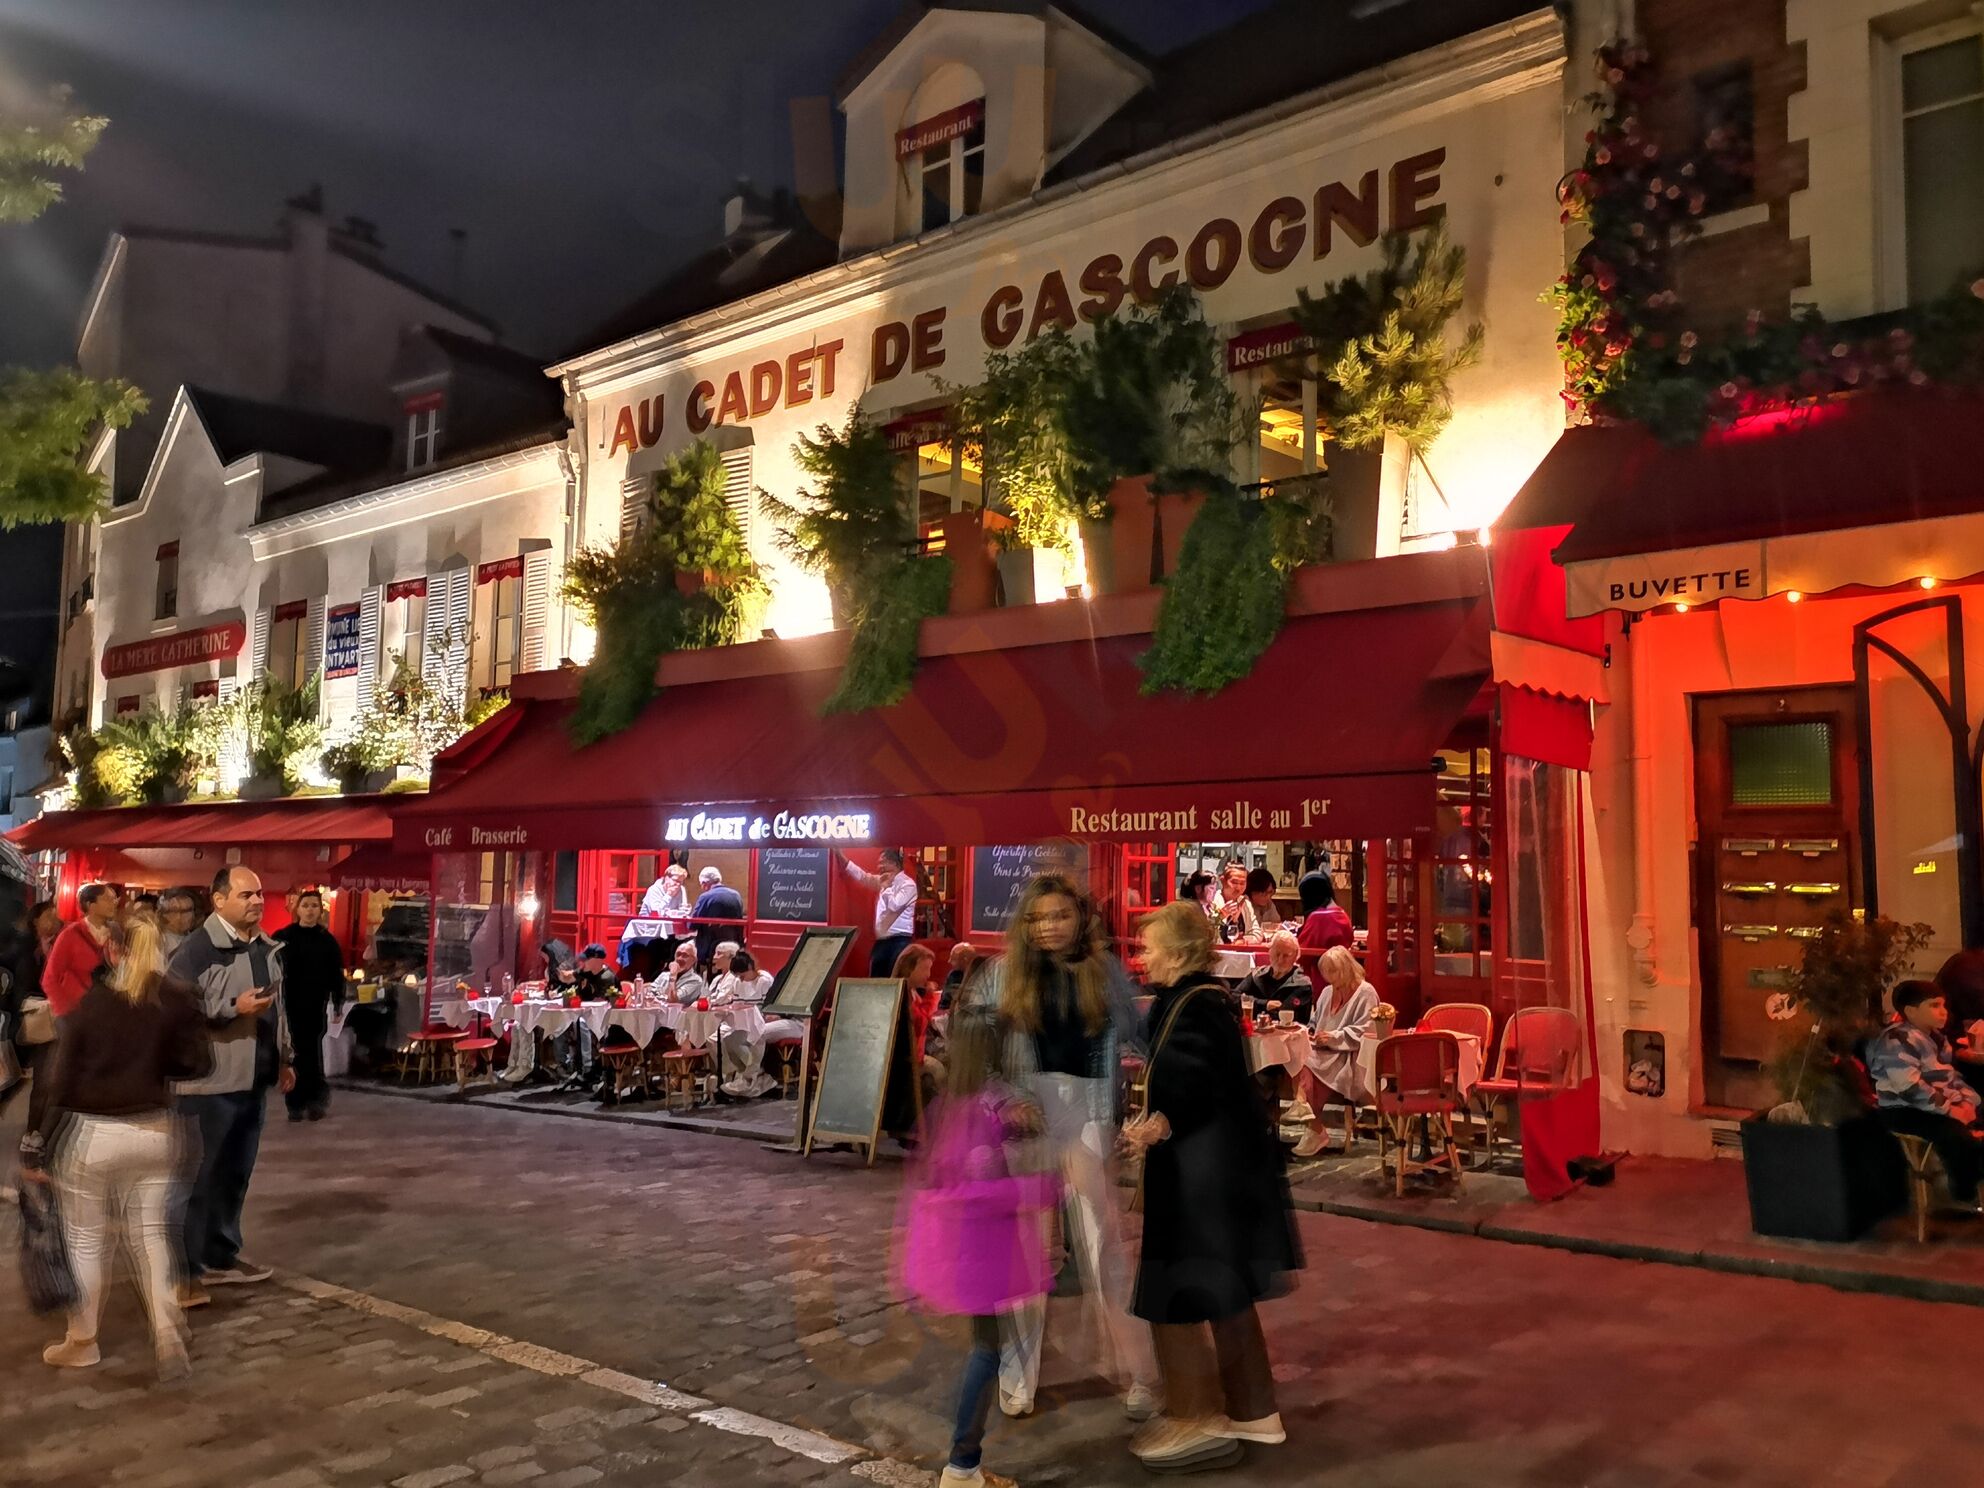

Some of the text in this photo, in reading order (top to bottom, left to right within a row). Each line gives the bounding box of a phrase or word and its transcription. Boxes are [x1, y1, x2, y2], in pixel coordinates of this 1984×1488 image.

[900, 114, 974, 154] Restaurant
[608, 394, 665, 458] AU
[686, 338, 844, 434] CADET
[871, 307, 947, 385] DE
[981, 147, 1446, 350] GASCOGNE
[1235, 335, 1323, 366] Restaua
[1610, 569, 1750, 602] BUVETTE
[111, 652, 124, 671] LA
[162, 630, 231, 663] CATHERINE
[665, 811, 869, 841] AU CADET de GASCOGNE
[1070, 798, 1332, 833] Restaurant salle au 1er
[425, 825, 528, 847] Café Brasserie
